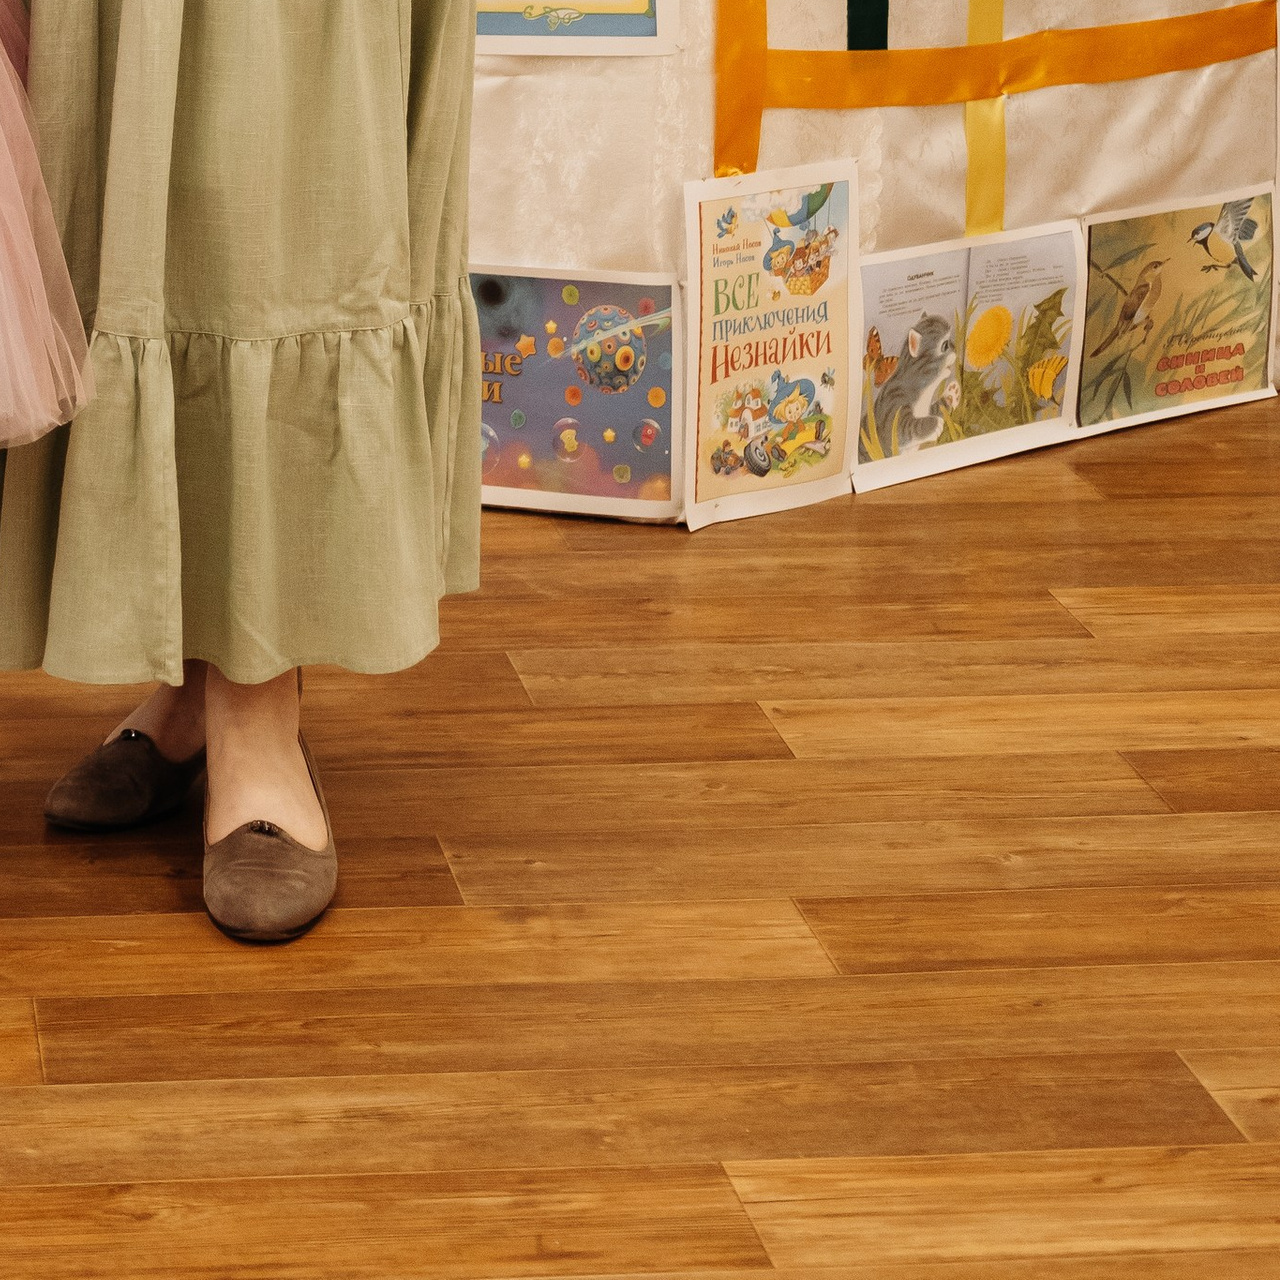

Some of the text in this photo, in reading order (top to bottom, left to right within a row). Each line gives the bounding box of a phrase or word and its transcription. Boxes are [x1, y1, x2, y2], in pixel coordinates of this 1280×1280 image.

[712, 238, 762, 256] Николай Носов
[713, 253, 755, 268] Игорь Носов
[713, 272, 760, 317] ВСЕ
[710, 327, 832, 385] Незнайки
[1157, 343, 1245, 372] СИНИЦА
[1155, 366, 1244, 397] СОЛОВЕЙ
